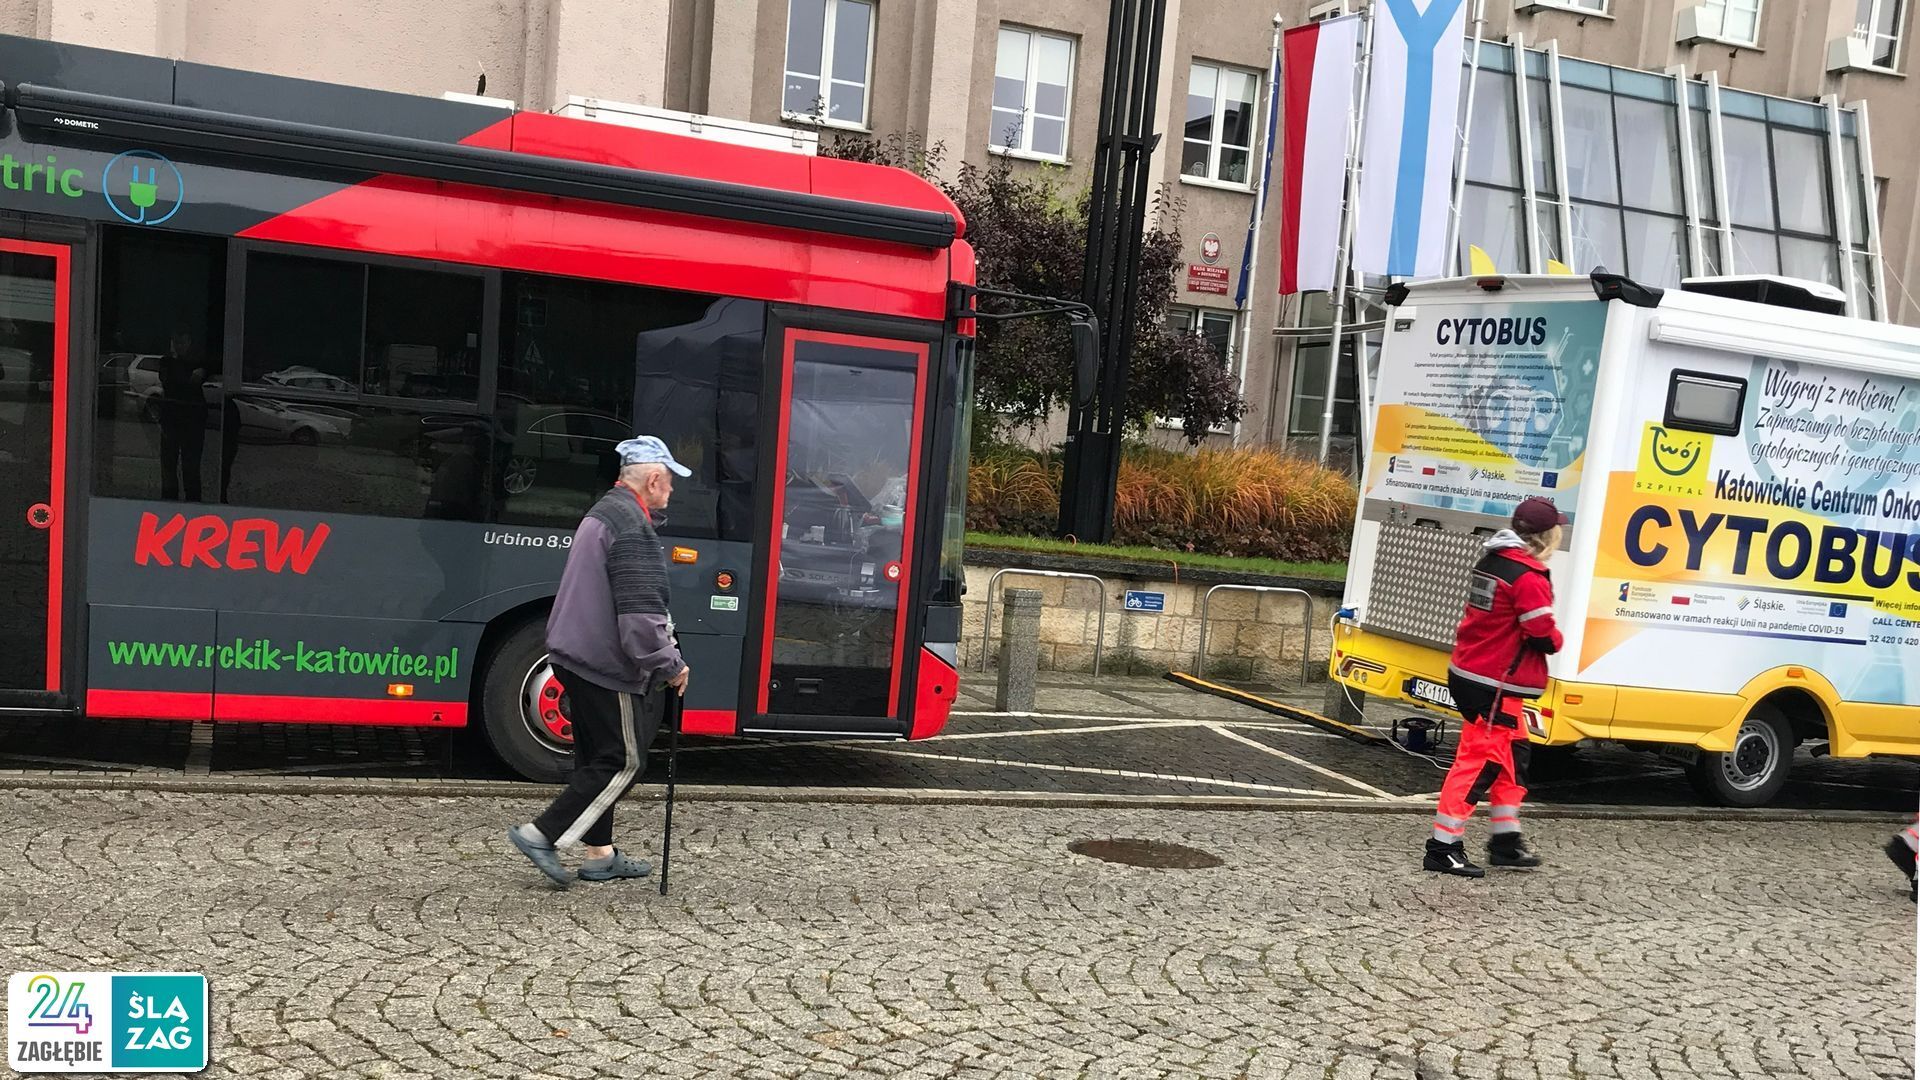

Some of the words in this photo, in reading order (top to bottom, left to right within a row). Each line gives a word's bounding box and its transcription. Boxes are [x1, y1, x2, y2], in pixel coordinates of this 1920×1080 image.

[64, 118, 99, 130] DOMETIC
[1436, 316, 1548, 346] CYTOBUS
[1764, 368, 1827, 412] Wygraj
[1825, 387, 1835, 404] z
[1841, 377, 1905, 413] rakiem!
[1754, 407, 1832, 438] Zapraszamy
[1834, 416, 1848, 437] do
[1751, 440, 1840, 468] cytologicznych
[1841, 448, 1847, 465] i
[1480, 466, 1506, 481] Śląskie.
[1386, 478, 1422, 490] Sfinansowano
[1429, 484, 1450, 493] ramach
[1450, 486, 1469, 497] reakcji
[1470, 488, 1482, 497] Unii
[1636, 481, 1704, 496] SZPITAL
[1714, 469, 1806, 509] Katowickie
[1811, 480, 1878, 517] Centrum
[134, 511, 331, 575] KREW
[483, 531, 544, 547] Urbino
[546, 535, 573, 550] 8,9
[1753, 598, 1786, 612] Śląskie.
[1875, 600, 1902, 611] Więcej
[1615, 608, 1671, 621] Sfinansowano
[1682, 614, 1712, 624] ramach
[1713, 616, 1739, 628] reakcji
[1740, 619, 1757, 629] Unii
[1757, 621, 1767, 629] na
[1808, 624, 1844, 635] COVID-19
[1872, 617, 1893, 627] CALL
[1869, 634, 1879, 643] 32
[1881, 635, 1895, 644] 420
[1897, 636, 1903, 644] 0
[1904, 637, 1919, 646] 420
[108, 637, 459, 684] www.rckik-katowice.pl
[1417, 681, 1430, 698] SK
